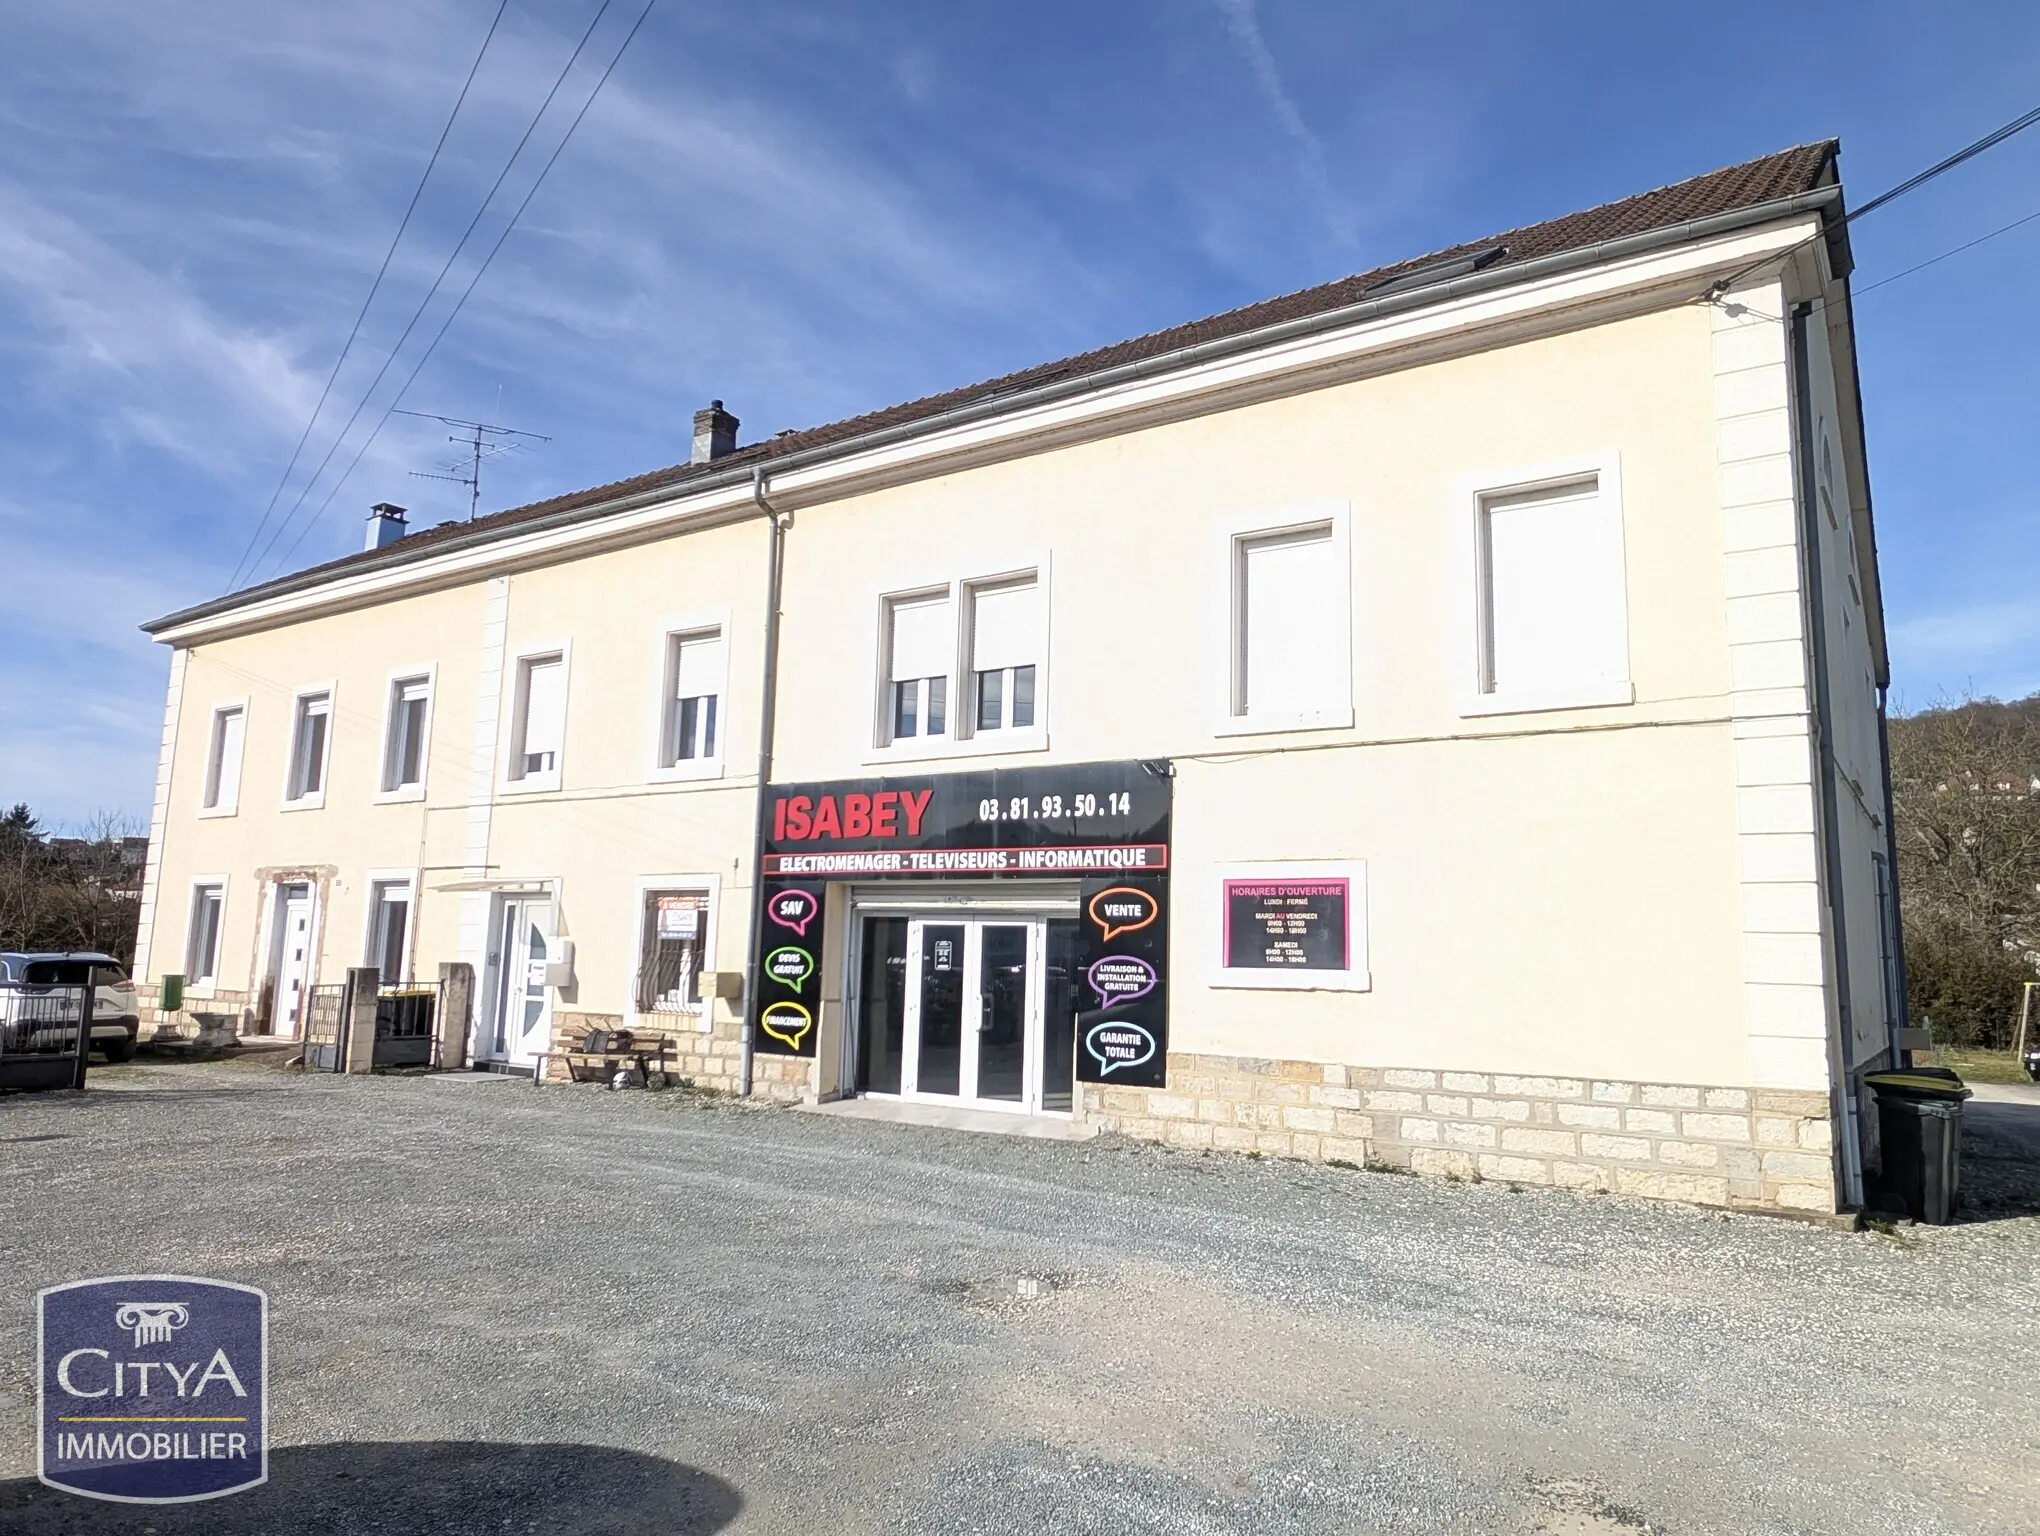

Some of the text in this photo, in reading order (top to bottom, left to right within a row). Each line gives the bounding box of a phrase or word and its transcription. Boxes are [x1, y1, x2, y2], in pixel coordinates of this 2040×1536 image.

[774, 790, 934, 842] ISABEY
[780, 854, 900, 872] ELECTROMENAGER
[910, 851, 1007, 869] TELEVISEURS
[1019, 848, 1146, 869] INFORMATIQUE
[1232, 886, 1342, 896] HORAIRES D'OUVERTURE
[780, 900, 804, 915] SAV
[1263, 898, 1283, 906] LUNDI
[1104, 904, 1142, 917] VENTE
[1255, 912, 1318, 920] MARDI AU VENDREDI
[1273, 941, 1299, 949] SAMEDI
[778, 953, 801, 963] DEVIS
[773, 964, 805, 975] GRATUIT
[1099, 964, 1144, 973] LIVRAISON &
[1097, 972, 1147, 983] INSTALLATION
[1104, 982, 1139, 991] GRATUITE
[1099, 1031, 1142, 1046] GARANTIE
[1105, 1045, 1136, 1059] TOTALE
